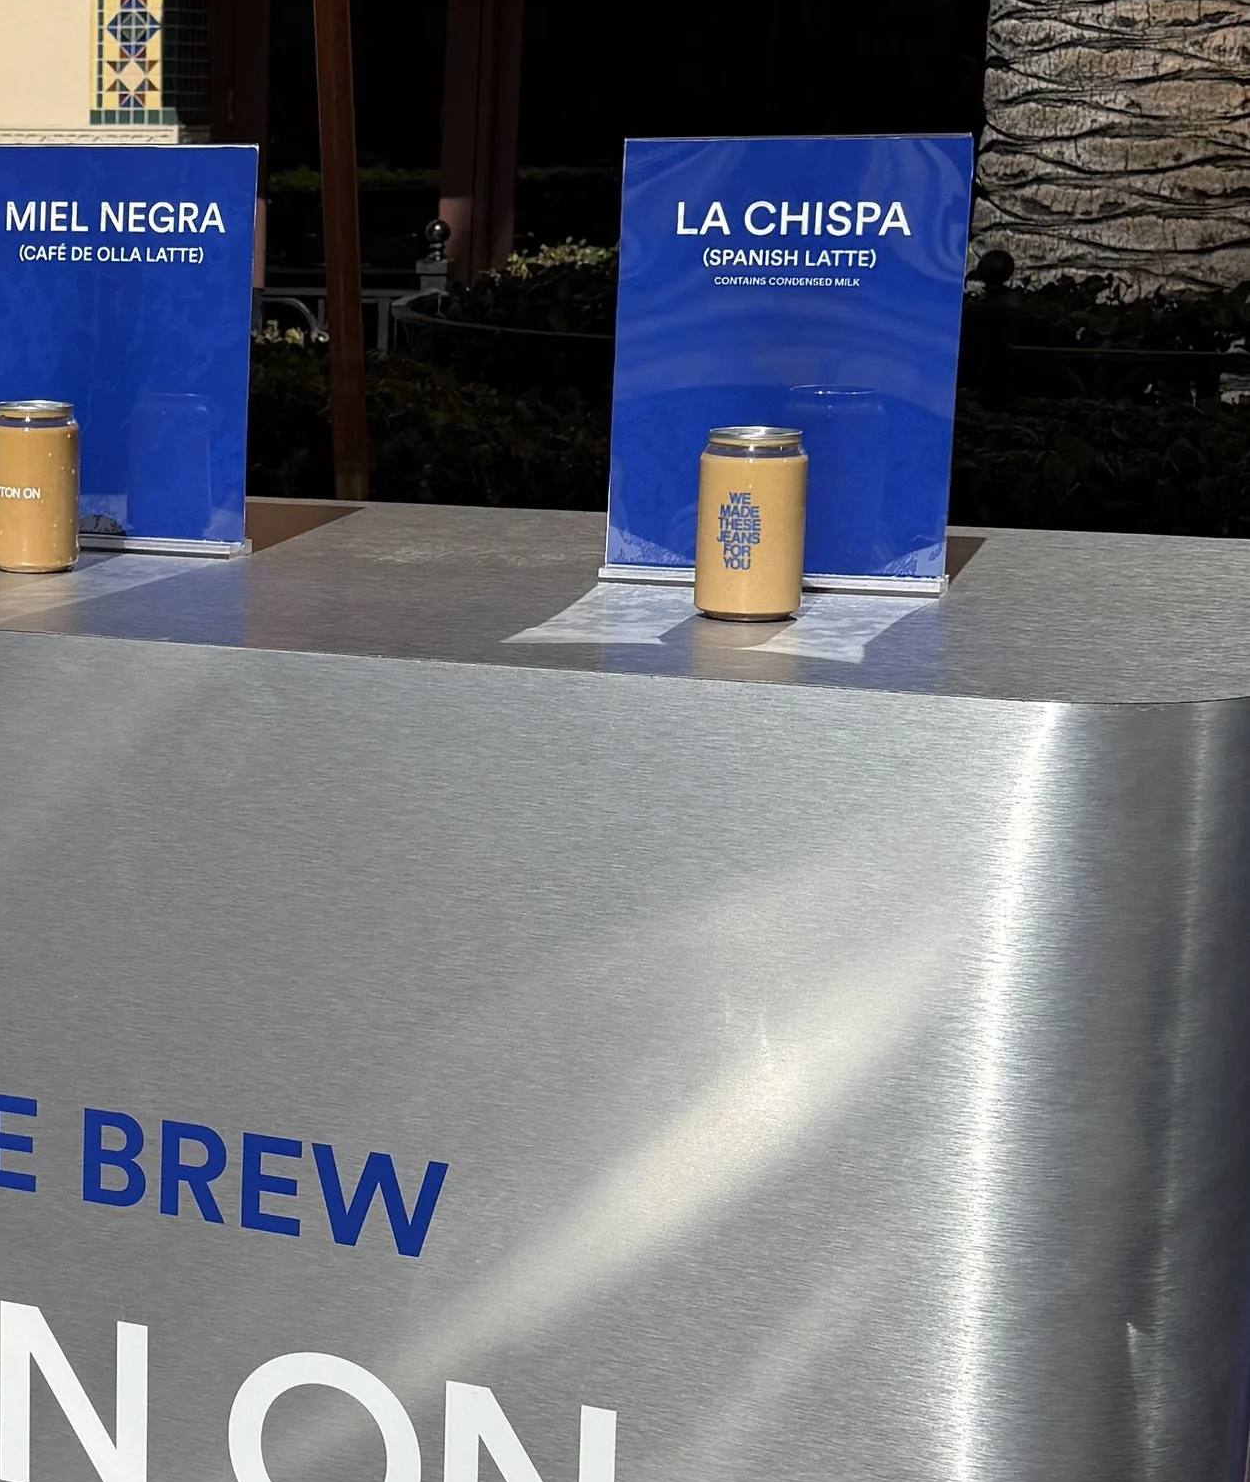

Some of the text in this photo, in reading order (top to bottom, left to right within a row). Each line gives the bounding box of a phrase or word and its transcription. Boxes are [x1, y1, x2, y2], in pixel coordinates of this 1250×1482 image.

[5, 200, 226, 234] MIEL NEGRA
[676, 200, 912, 237] LA CHISPA
[19, 242, 204, 264] (CAFÉ DE OLLA LATTE)
[702, 247, 877, 269] (SPANISH LATTE)
[713, 276, 860, 287] CONTAINS CONDENSED MILK
[22, 487, 42, 499] ON
[729, 491, 752, 505] WE
[720, 504, 760, 518] MADE
[718, 516, 761, 531] THESE
[717, 530, 760, 544] JEANS
[723, 543, 752, 557] FOR
[722, 556, 751, 570] YOU
[82, 1107, 449, 1258] BREW
